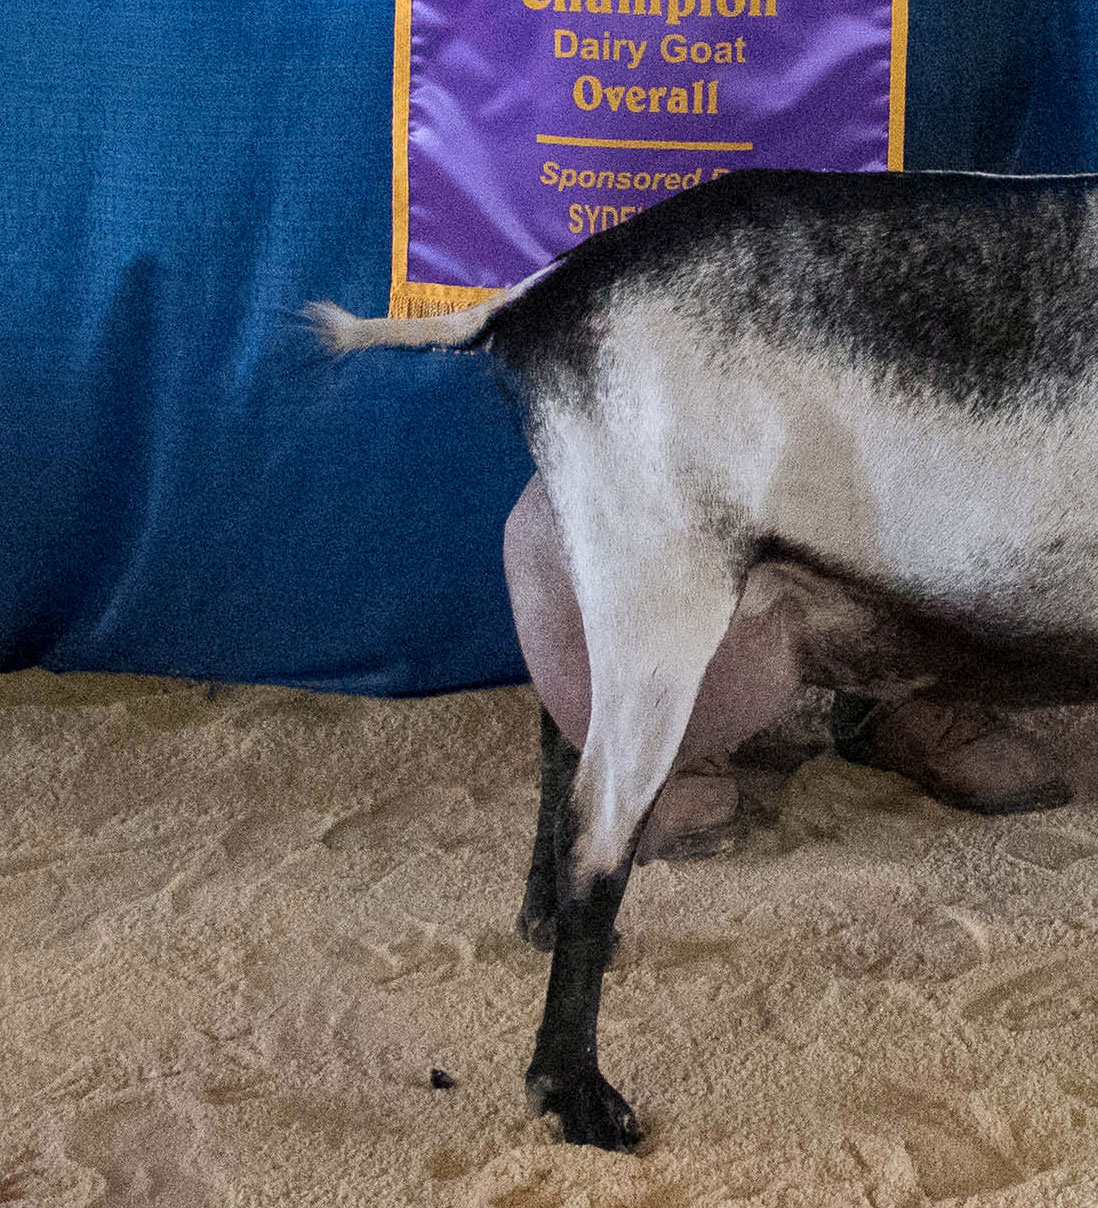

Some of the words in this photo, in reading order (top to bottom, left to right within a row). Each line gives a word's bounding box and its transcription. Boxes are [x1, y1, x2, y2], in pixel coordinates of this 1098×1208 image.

[553, 28, 647, 69] Dairy
[660, 33, 746, 64] Goat
[572, 75, 719, 115] Overall
[539, 161, 703, 192] Sponsored
